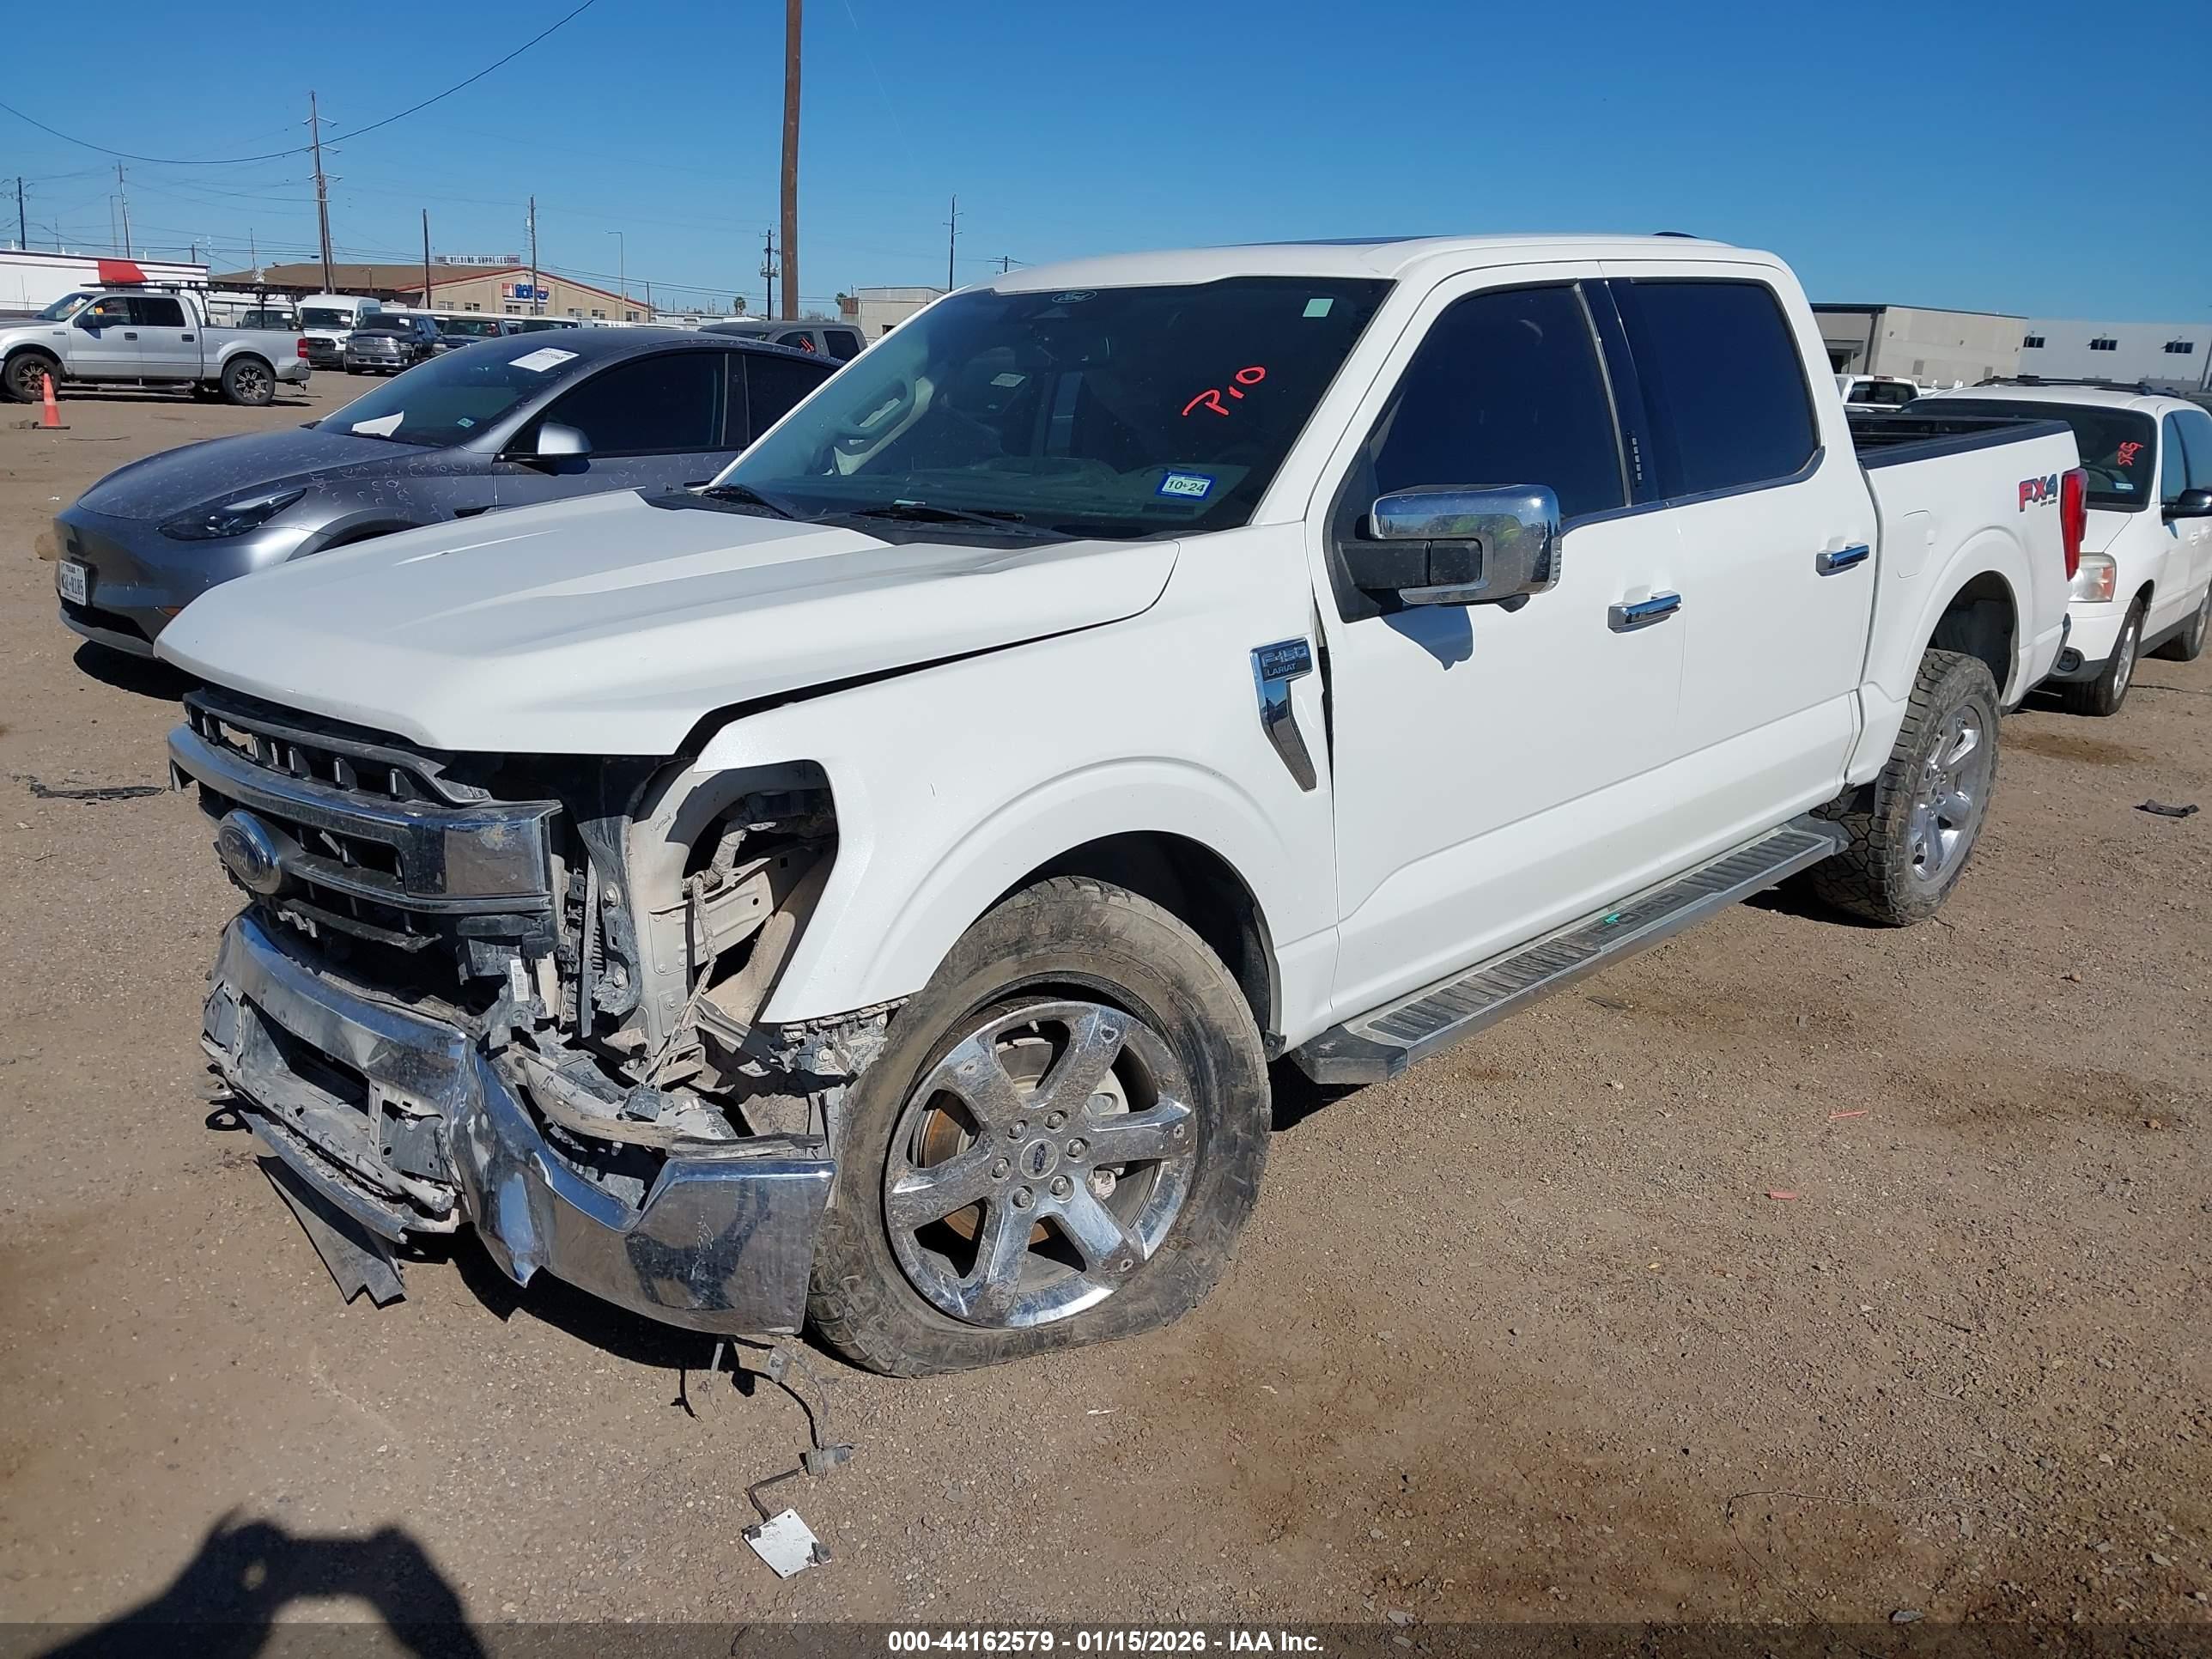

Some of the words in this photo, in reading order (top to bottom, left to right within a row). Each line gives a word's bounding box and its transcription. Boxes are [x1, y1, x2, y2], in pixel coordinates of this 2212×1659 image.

[2019, 474, 2057, 513] FX4
[1267, 664, 1296, 676] LARIAT
[226, 834, 250, 873] Ford
